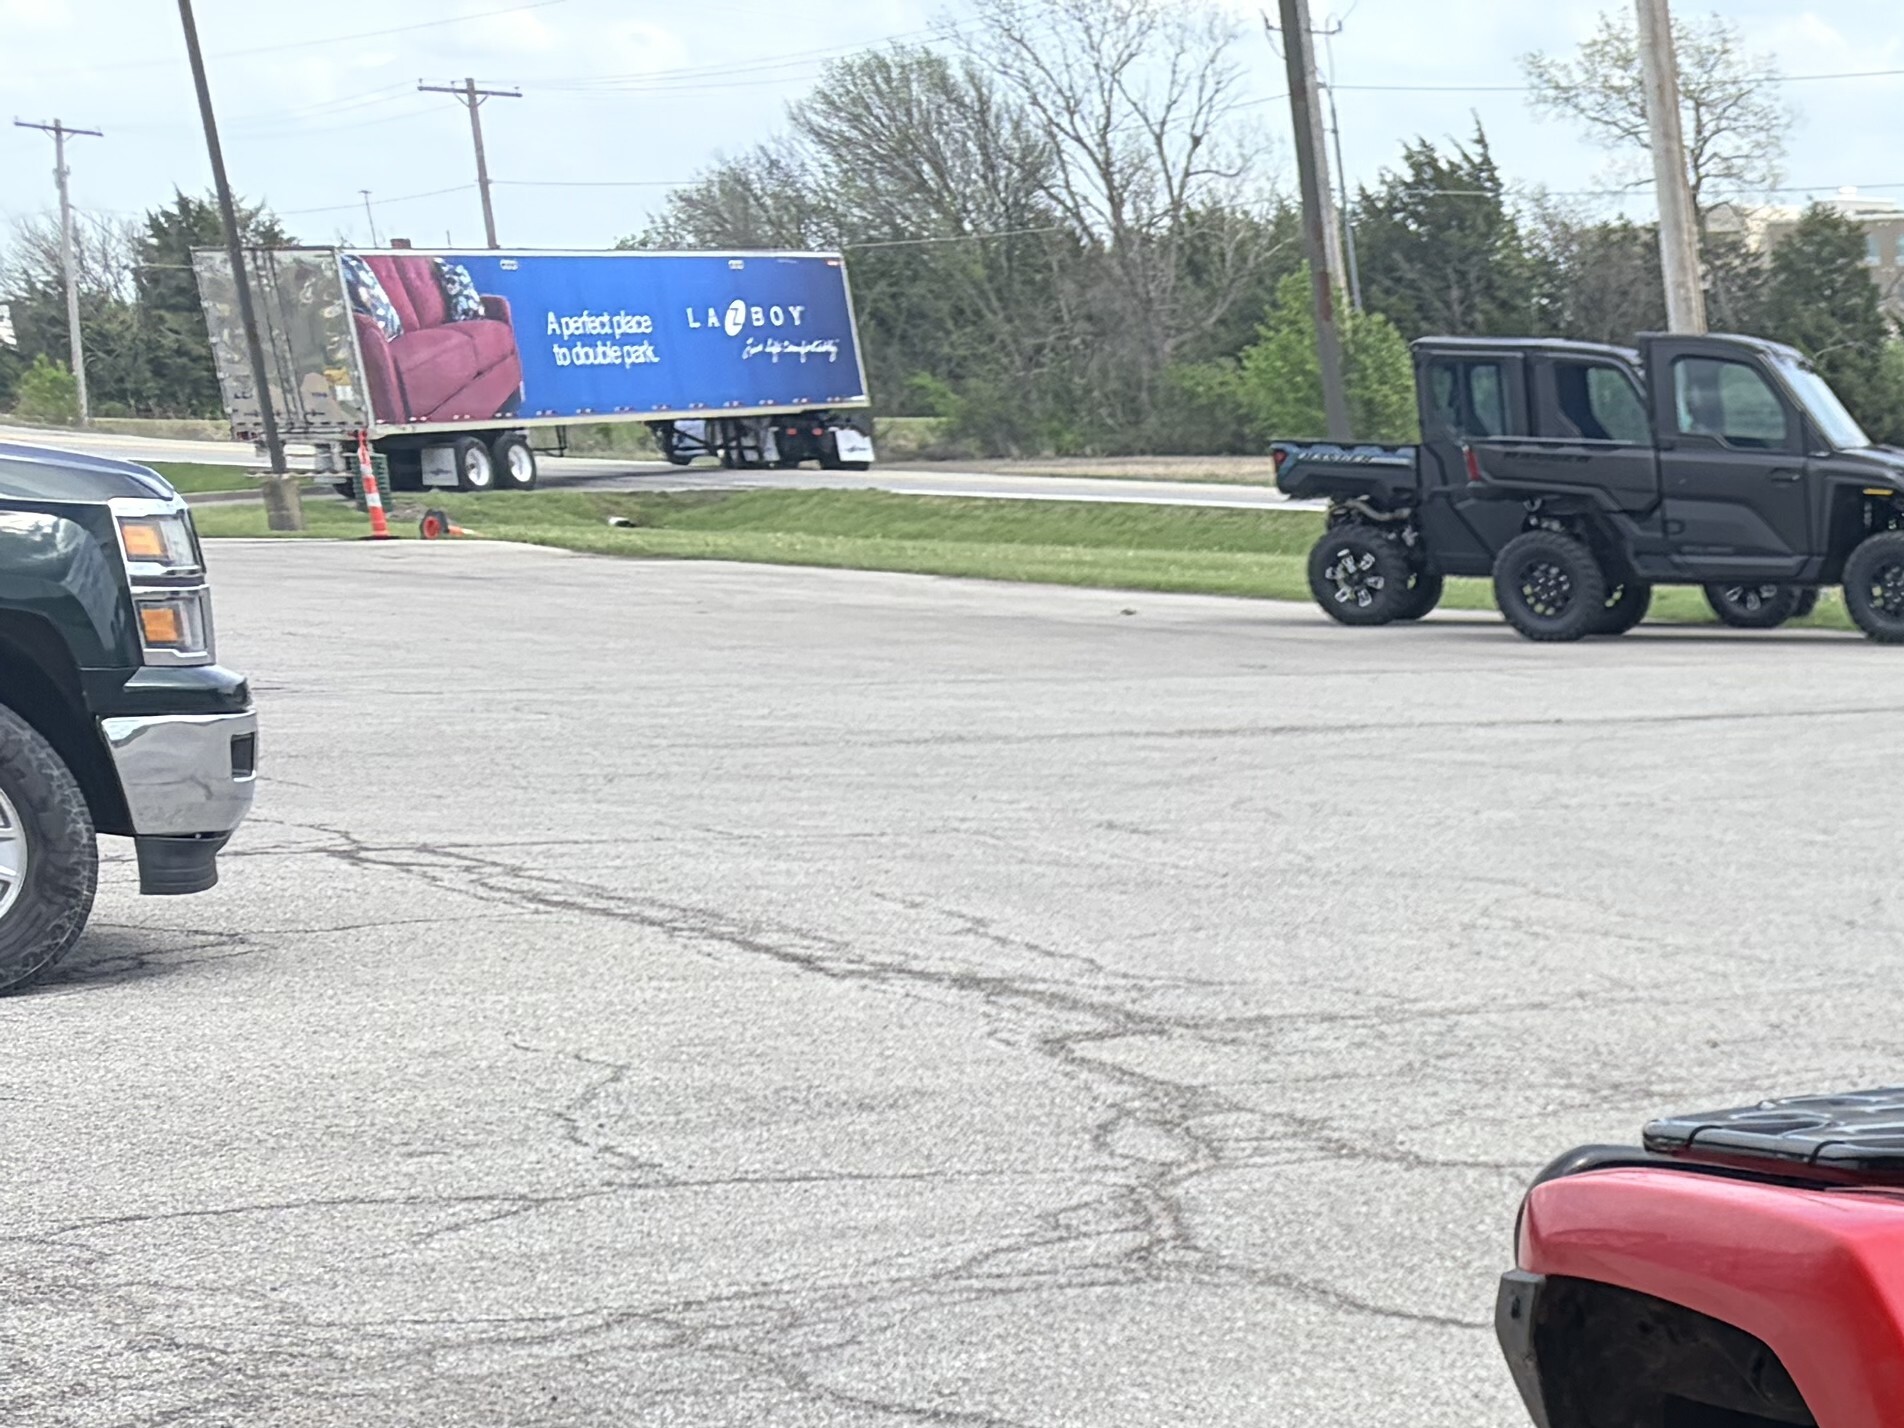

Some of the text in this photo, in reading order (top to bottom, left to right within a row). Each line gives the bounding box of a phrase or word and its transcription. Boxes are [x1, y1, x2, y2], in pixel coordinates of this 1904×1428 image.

[546, 309, 653, 340] A perfect place
[552, 343, 571, 366] to
[571, 341, 622, 365] double
